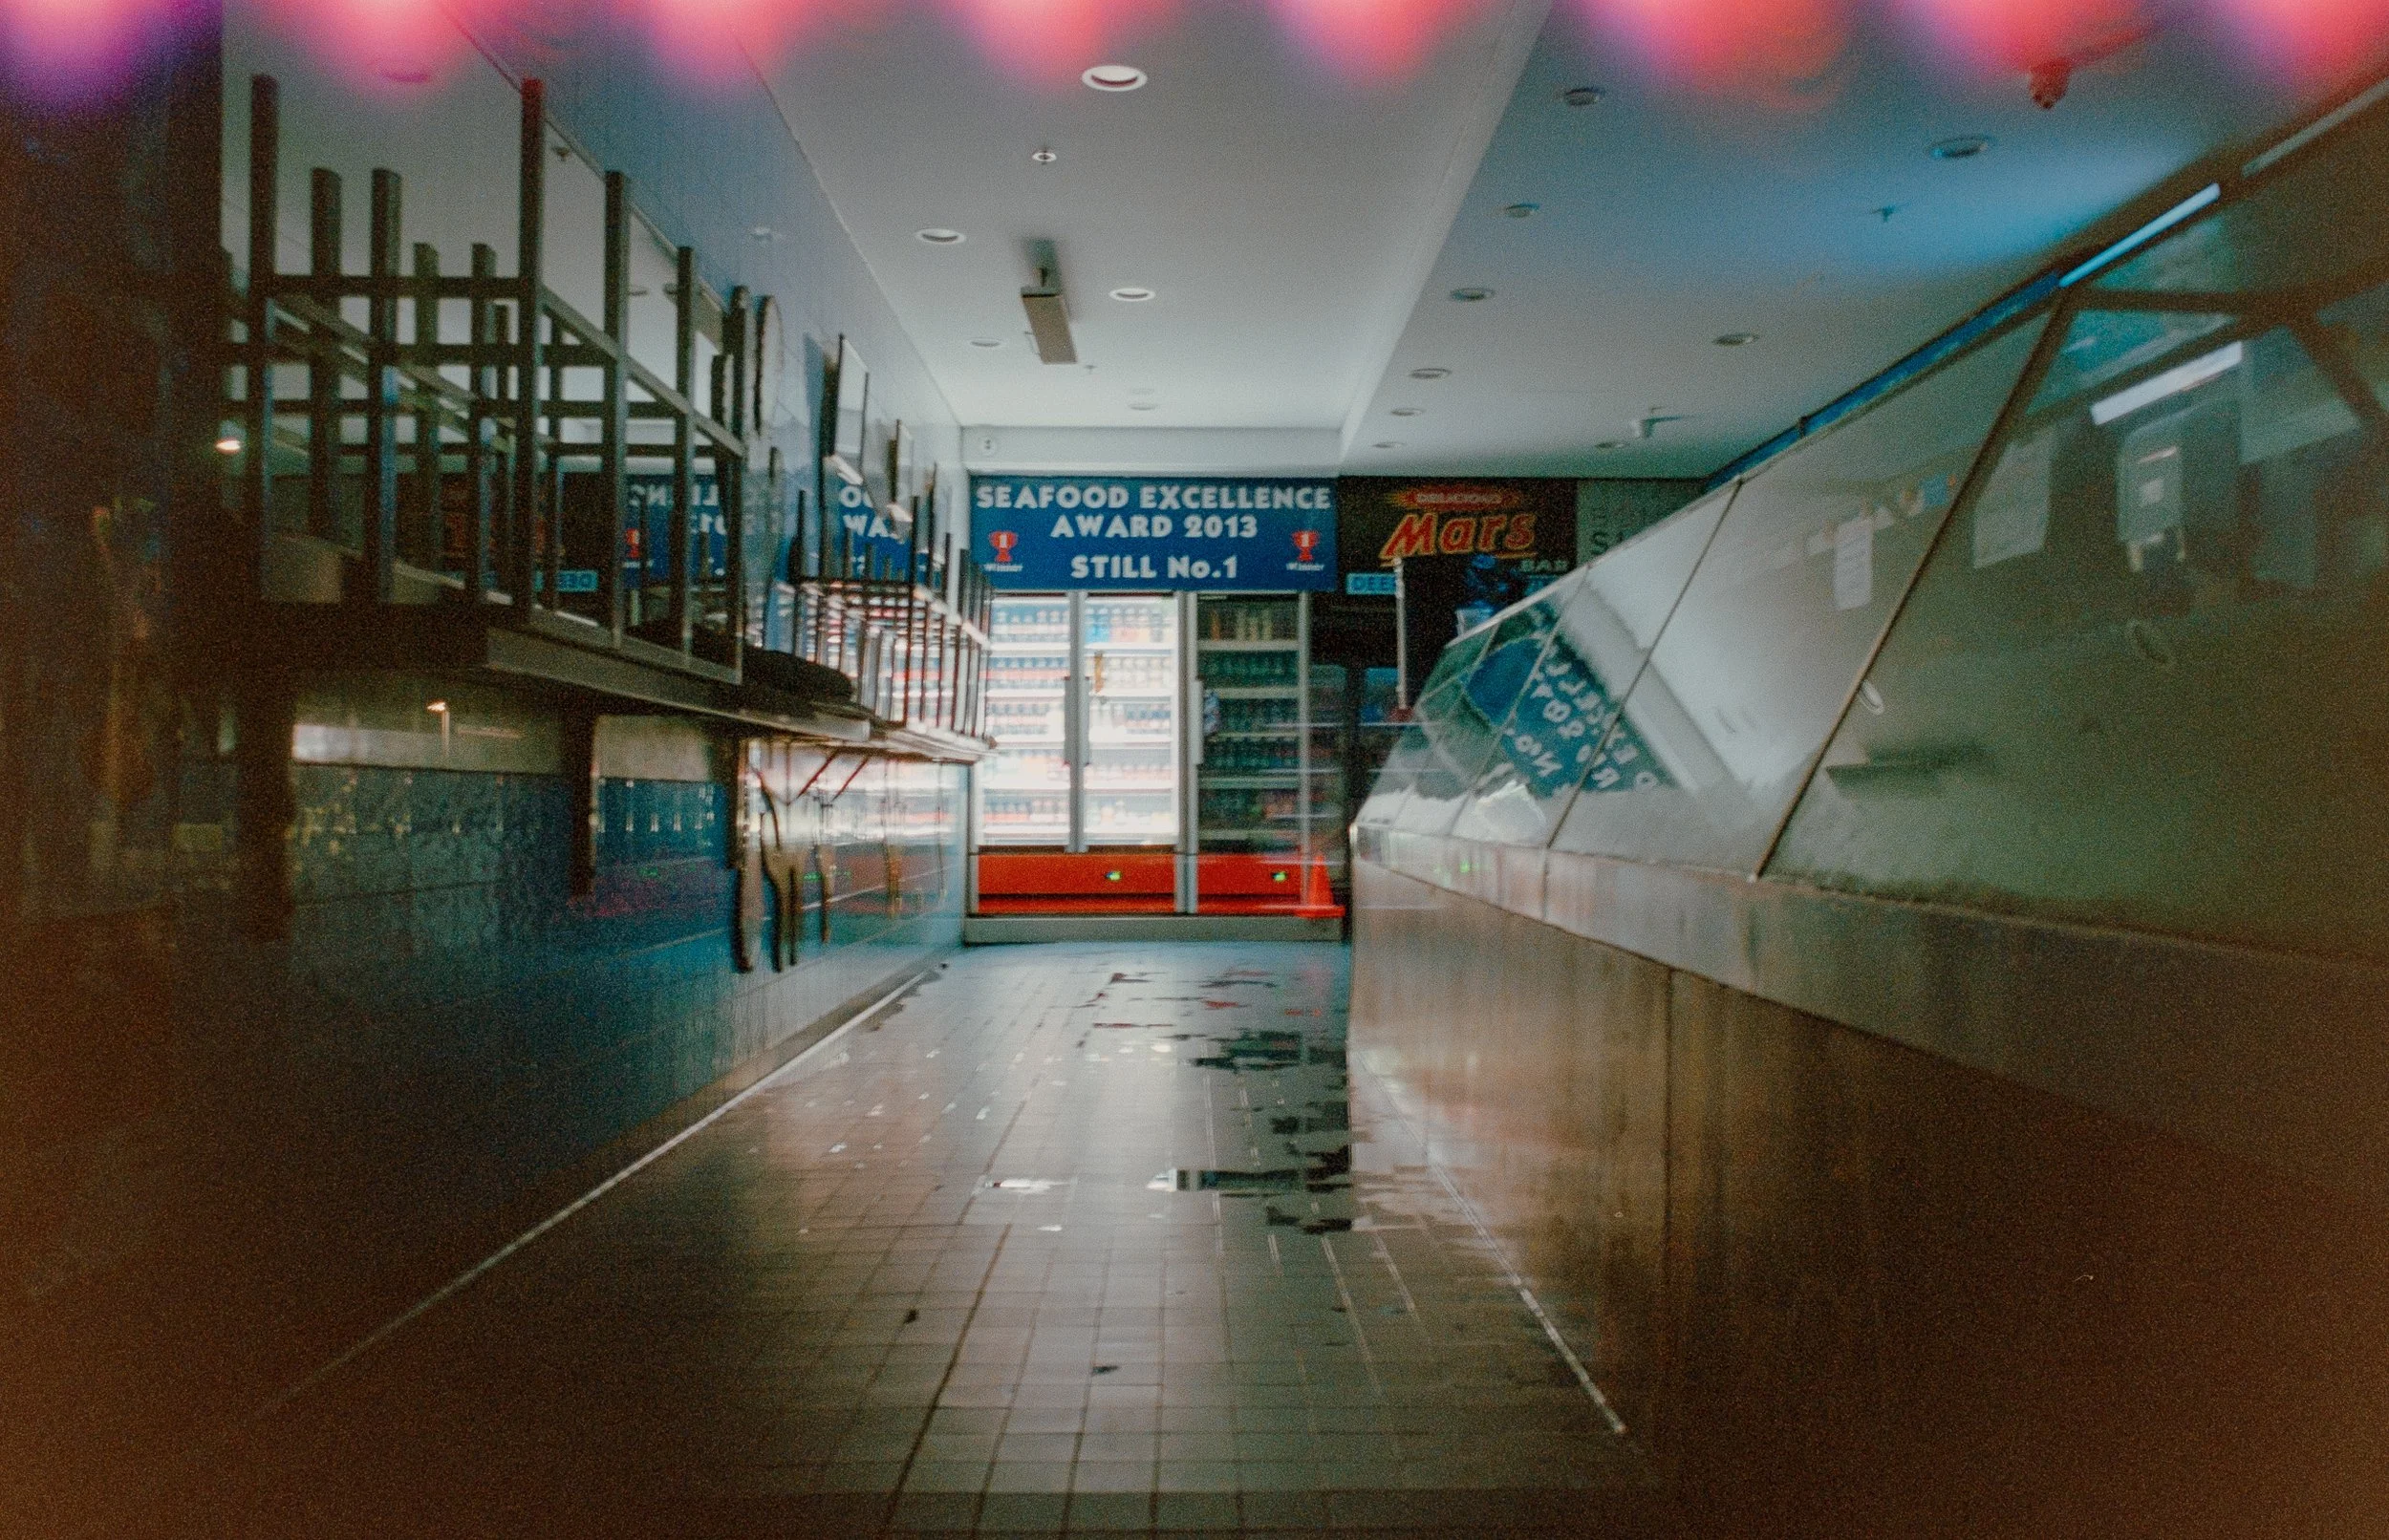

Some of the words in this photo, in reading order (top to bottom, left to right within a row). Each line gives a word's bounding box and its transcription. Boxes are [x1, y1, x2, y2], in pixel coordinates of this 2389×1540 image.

[976, 485, 1129, 509] SEAFOOD
[1139, 485, 1332, 509] EXCELLENCE
[1050, 514, 1173, 538] AWARD
[1184, 514, 1258, 538] 2013
[1380, 512, 1538, 560] Mars
[1071, 555, 1156, 579] STILL
[1168, 555, 1238, 579] No.1
[1351, 576, 1396, 591] DEE
